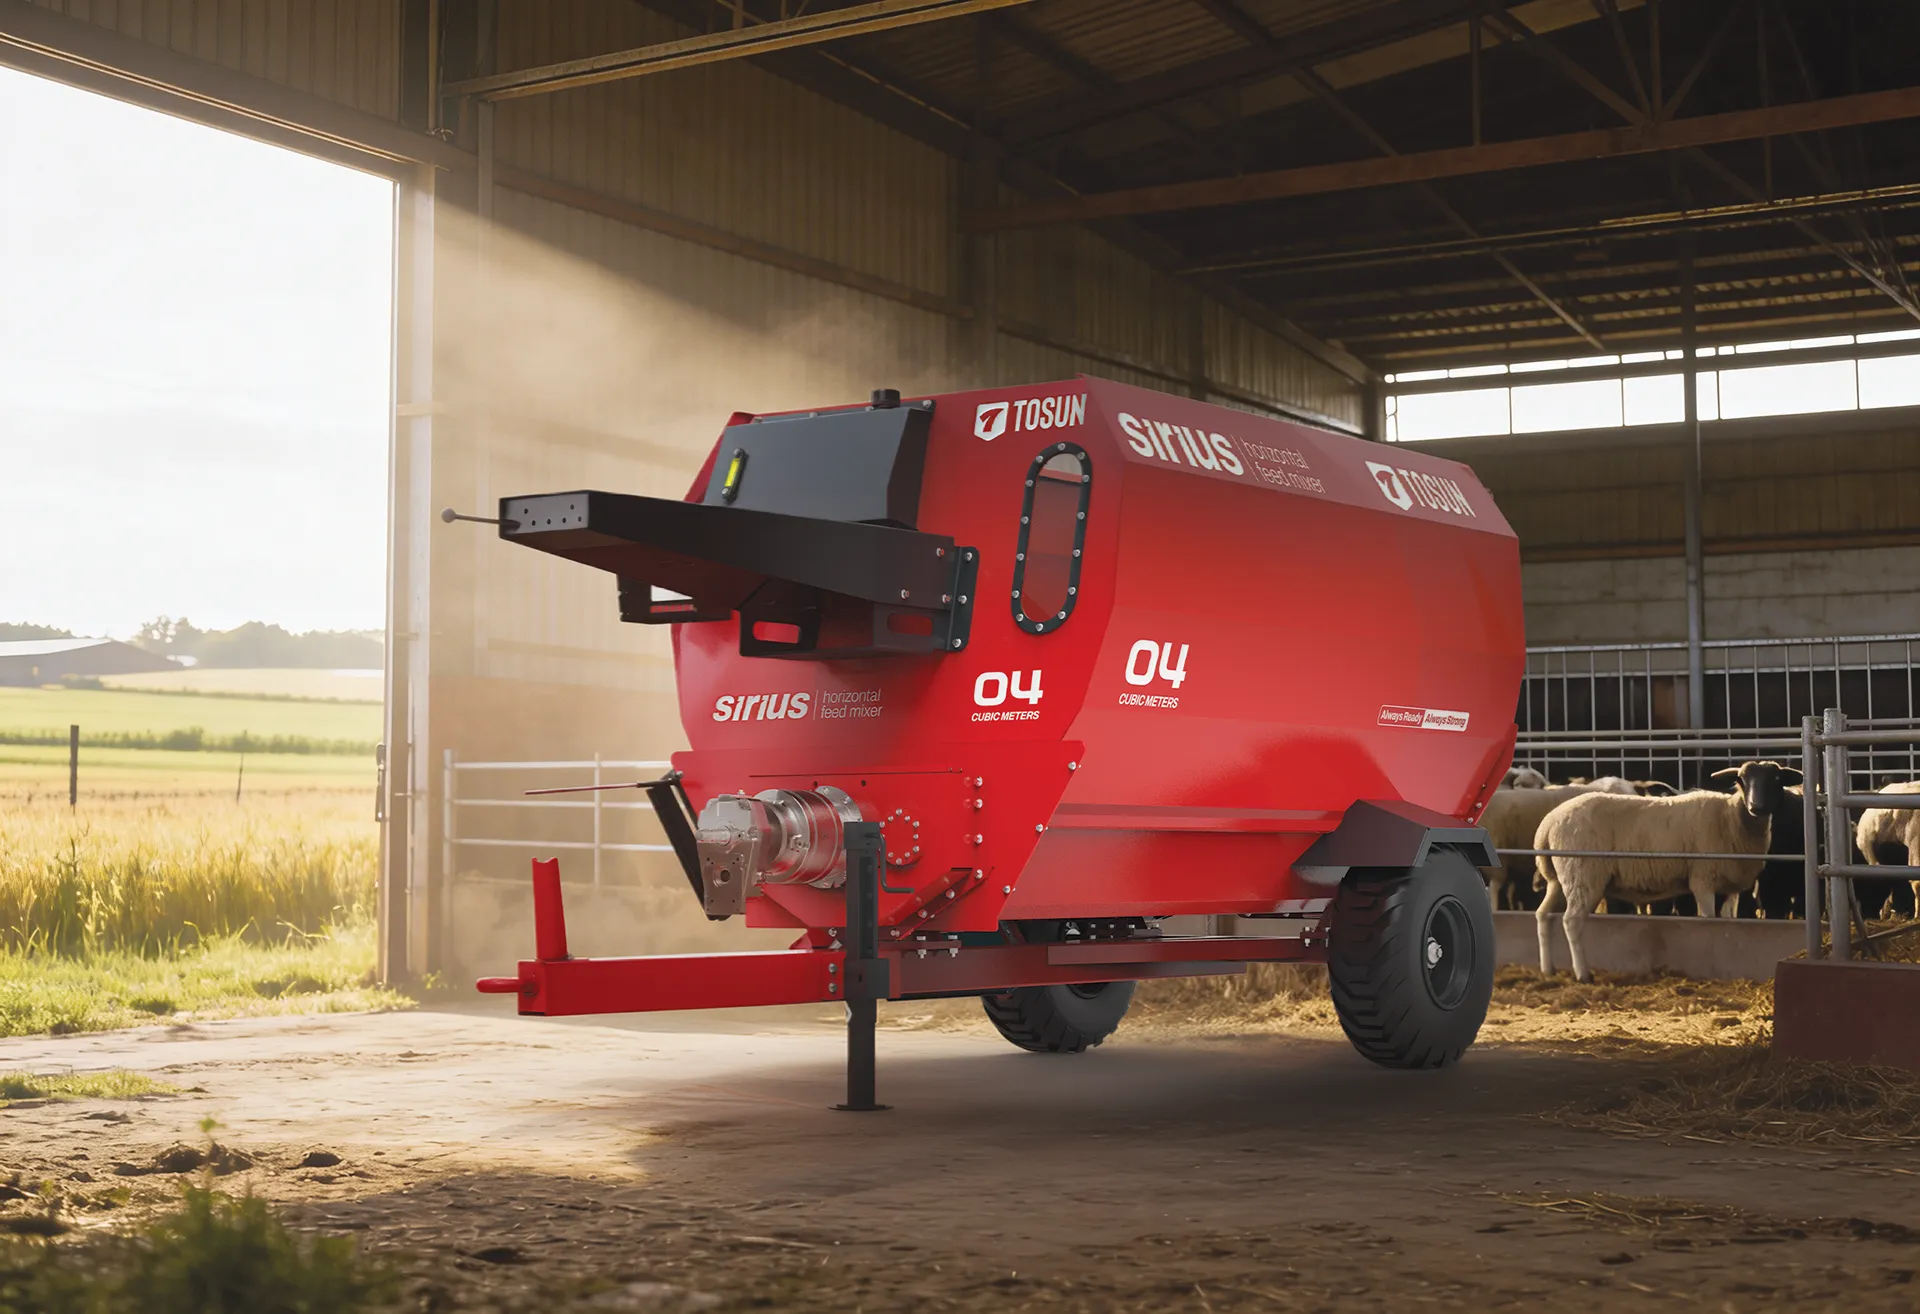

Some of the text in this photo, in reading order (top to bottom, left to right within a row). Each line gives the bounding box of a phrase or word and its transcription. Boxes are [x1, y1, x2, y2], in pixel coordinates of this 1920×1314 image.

[1013, 393, 1087, 432] TOSUN
[1117, 412, 1244, 476] sirius
[1241, 437, 1310, 470] horizontal
[1255, 462, 1326, 494] feed mixer
[1399, 467, 1476, 517] TOSUN
[1125, 639, 1189, 689] 04
[822, 688, 881, 704] horizontal
[973, 669, 1043, 707] 04
[1118, 693, 1179, 709] CUBIC METERS
[712, 692, 810, 722] sirius
[820, 703, 883, 719] feed mixer
[971, 710, 1040, 722] CUBIC METERS
[1380, 709, 1423, 725] Always Ready
[1424, 713, 1466, 728] Always Strong
